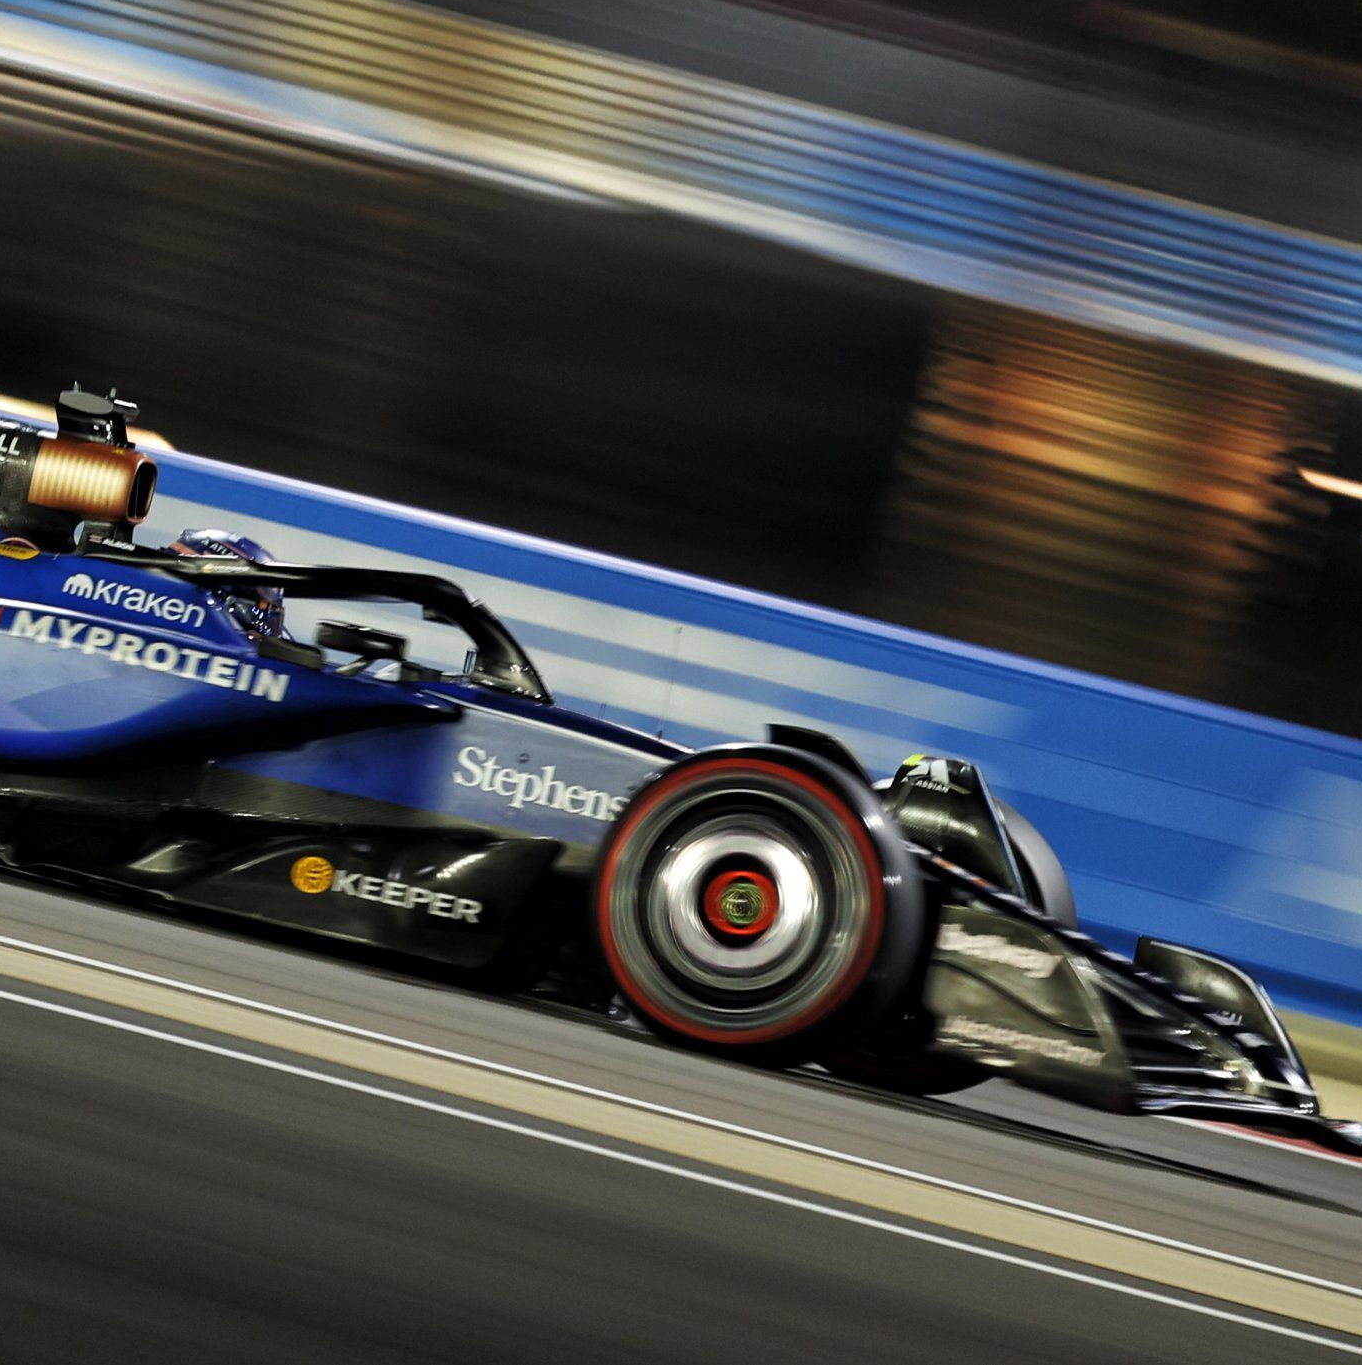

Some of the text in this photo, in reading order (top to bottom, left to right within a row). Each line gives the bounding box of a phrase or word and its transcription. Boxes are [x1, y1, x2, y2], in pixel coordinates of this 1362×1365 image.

[92, 579, 206, 628] kraken
[9, 609, 291, 702] MYPROTEIN
[453, 746, 631, 822] Stephens
[331, 869, 484, 923] KEEPER
